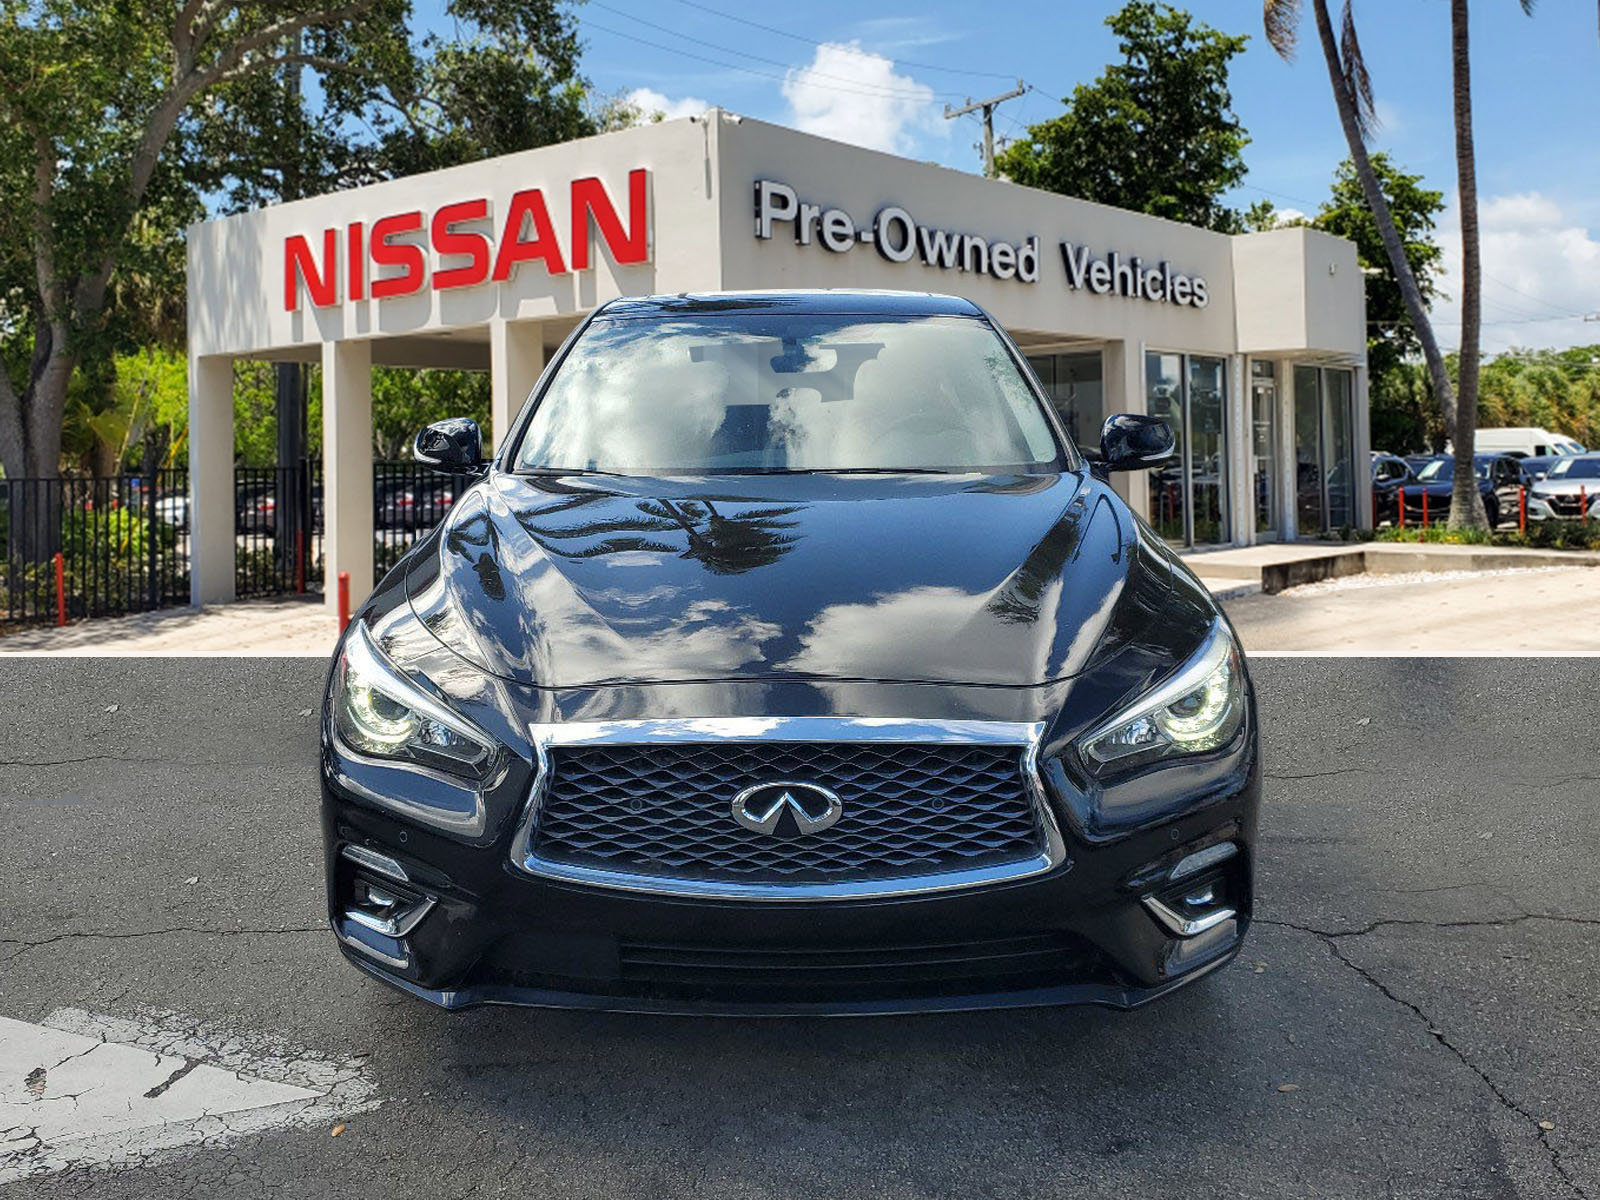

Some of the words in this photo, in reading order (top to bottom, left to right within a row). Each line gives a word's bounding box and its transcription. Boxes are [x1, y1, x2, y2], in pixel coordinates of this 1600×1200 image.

[285, 168, 648, 312] NISSAN
[754, 179, 1041, 284] Pre-Owned
[1060, 241, 1209, 309] Vehicles
